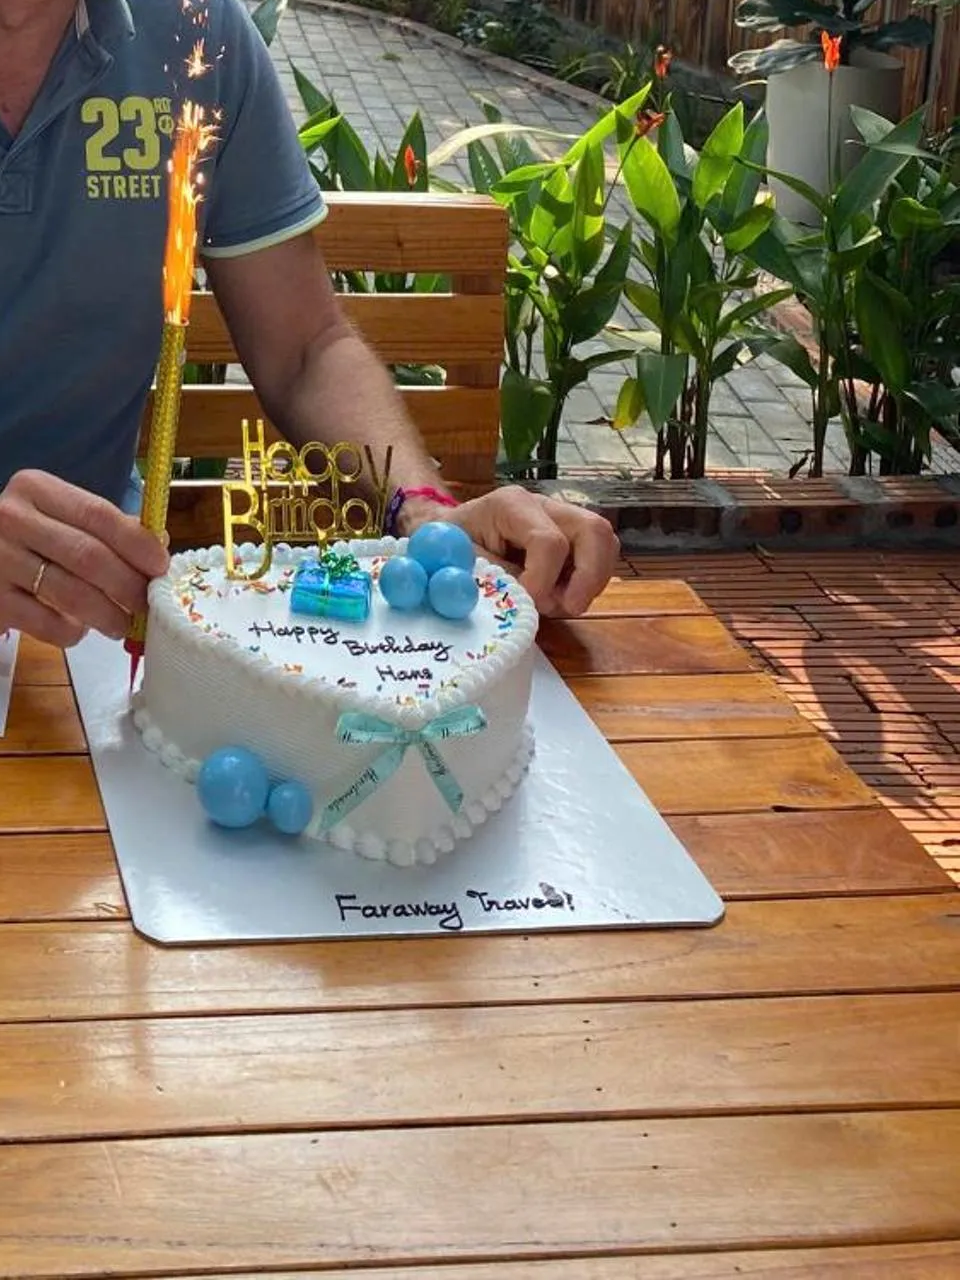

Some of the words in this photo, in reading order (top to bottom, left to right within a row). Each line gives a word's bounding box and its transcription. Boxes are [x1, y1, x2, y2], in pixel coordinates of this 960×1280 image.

[86, 174, 162, 199] STREET
[248, 620, 341, 645] Happy
[341, 625, 455, 662] Birthday
[335, 893, 464, 931] Faraway
